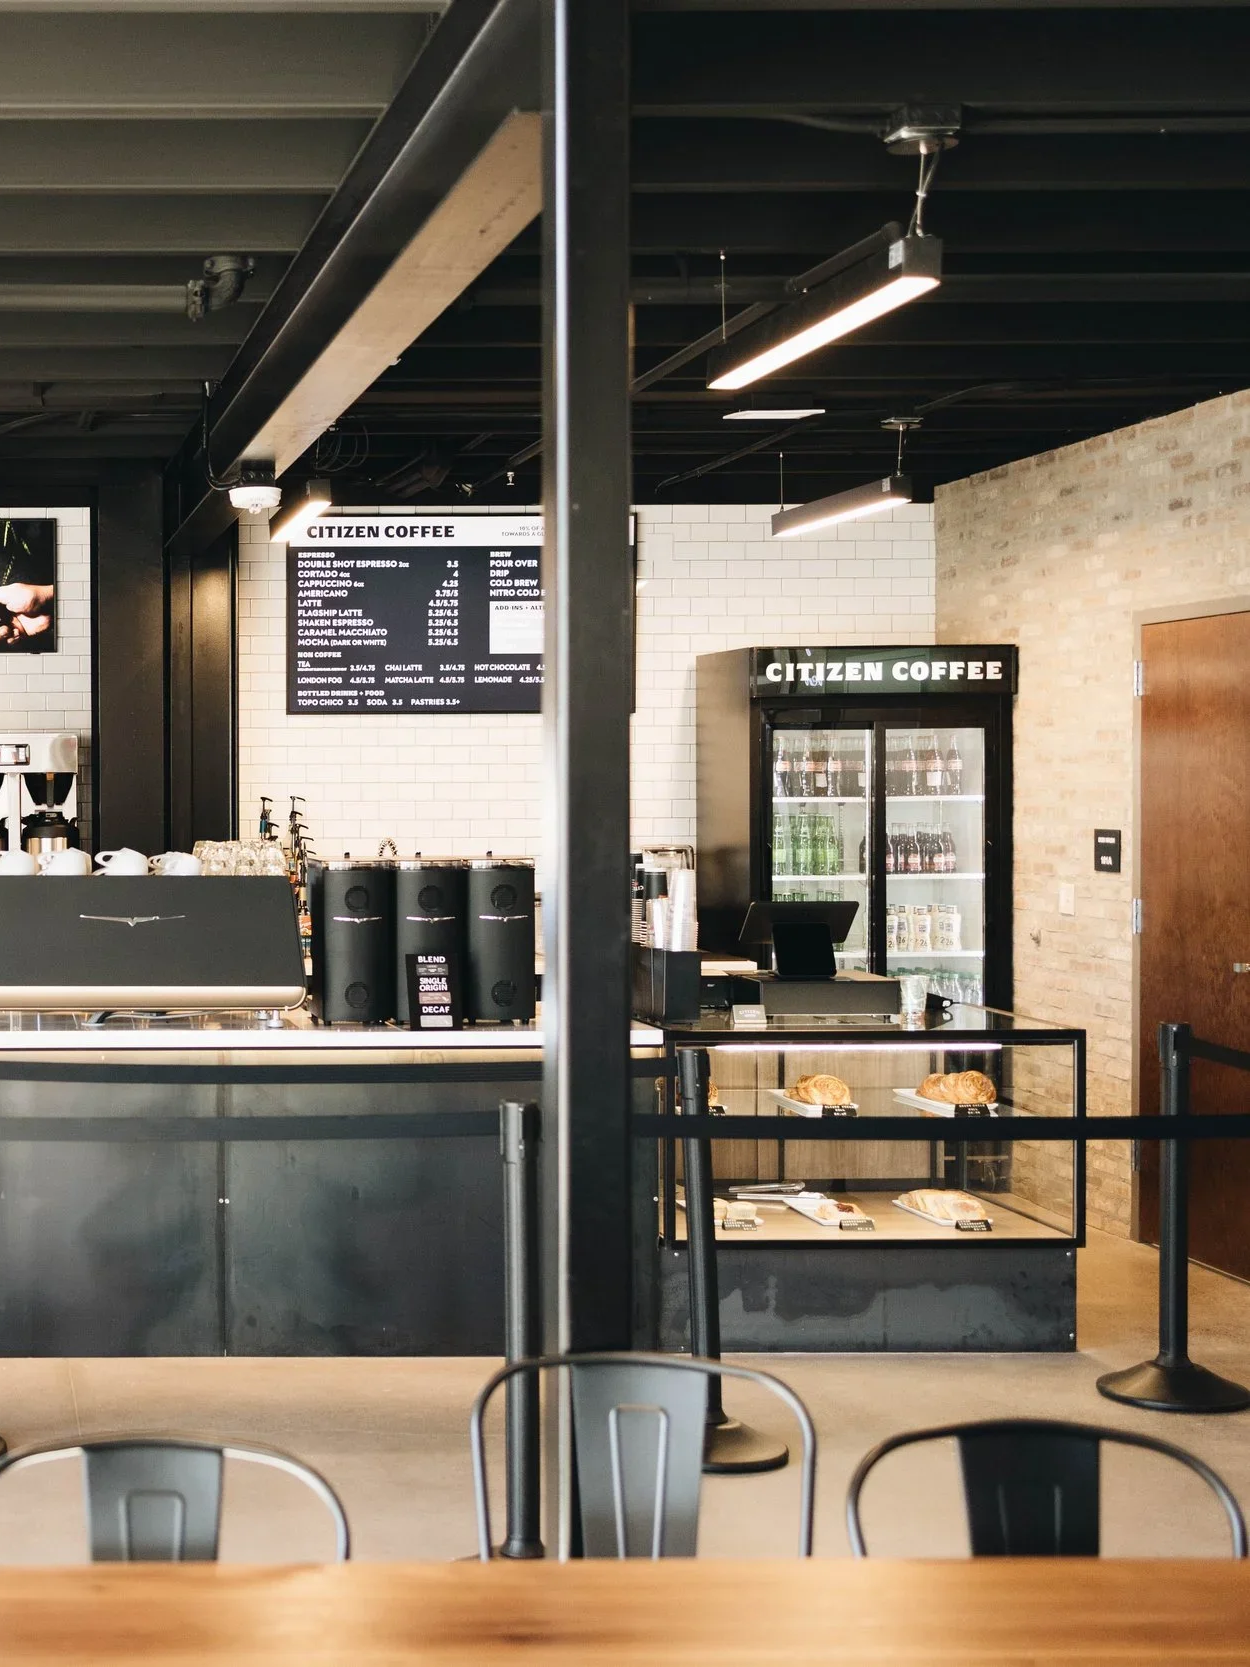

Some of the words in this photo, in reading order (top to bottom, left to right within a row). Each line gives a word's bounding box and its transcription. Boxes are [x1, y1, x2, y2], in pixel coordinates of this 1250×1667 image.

[306, 525, 380, 538] CITIZEN
[384, 525, 455, 538] COFFEE
[297, 560, 331, 568] DOUBLE
[332, 560, 355, 568] SHOT
[356, 560, 398, 568] ESPRESSO
[446, 560, 459, 568] 3.5
[297, 570, 338, 578] CORTADO
[442, 580, 459, 588] 4.25
[489, 579, 513, 587] COLD
[514, 579, 538, 587] BREW
[489, 589, 516, 597] NITRO
[516, 589, 540, 597] COLD
[297, 609, 337, 617] FLAGSHIP
[338, 609, 363, 617] LATTE
[427, 609, 459, 617] 5.25/6.5
[297, 619, 331, 627] SHAKEN
[332, 619, 374, 627] ESPRESSO
[427, 619, 459, 627] 5.25/6.5
[330, 639, 351, 647] (DARK
[363, 639, 387, 647] WHITE)
[765, 662, 883, 681] CITIZEN
[892, 661, 1002, 681] COFFEE
[474, 676, 513, 684] LEMONADE
[417, 955, 446, 963] BLEND
[419, 977, 447, 985] SINGLE
[422, 1005, 450, 1013] DECAF
